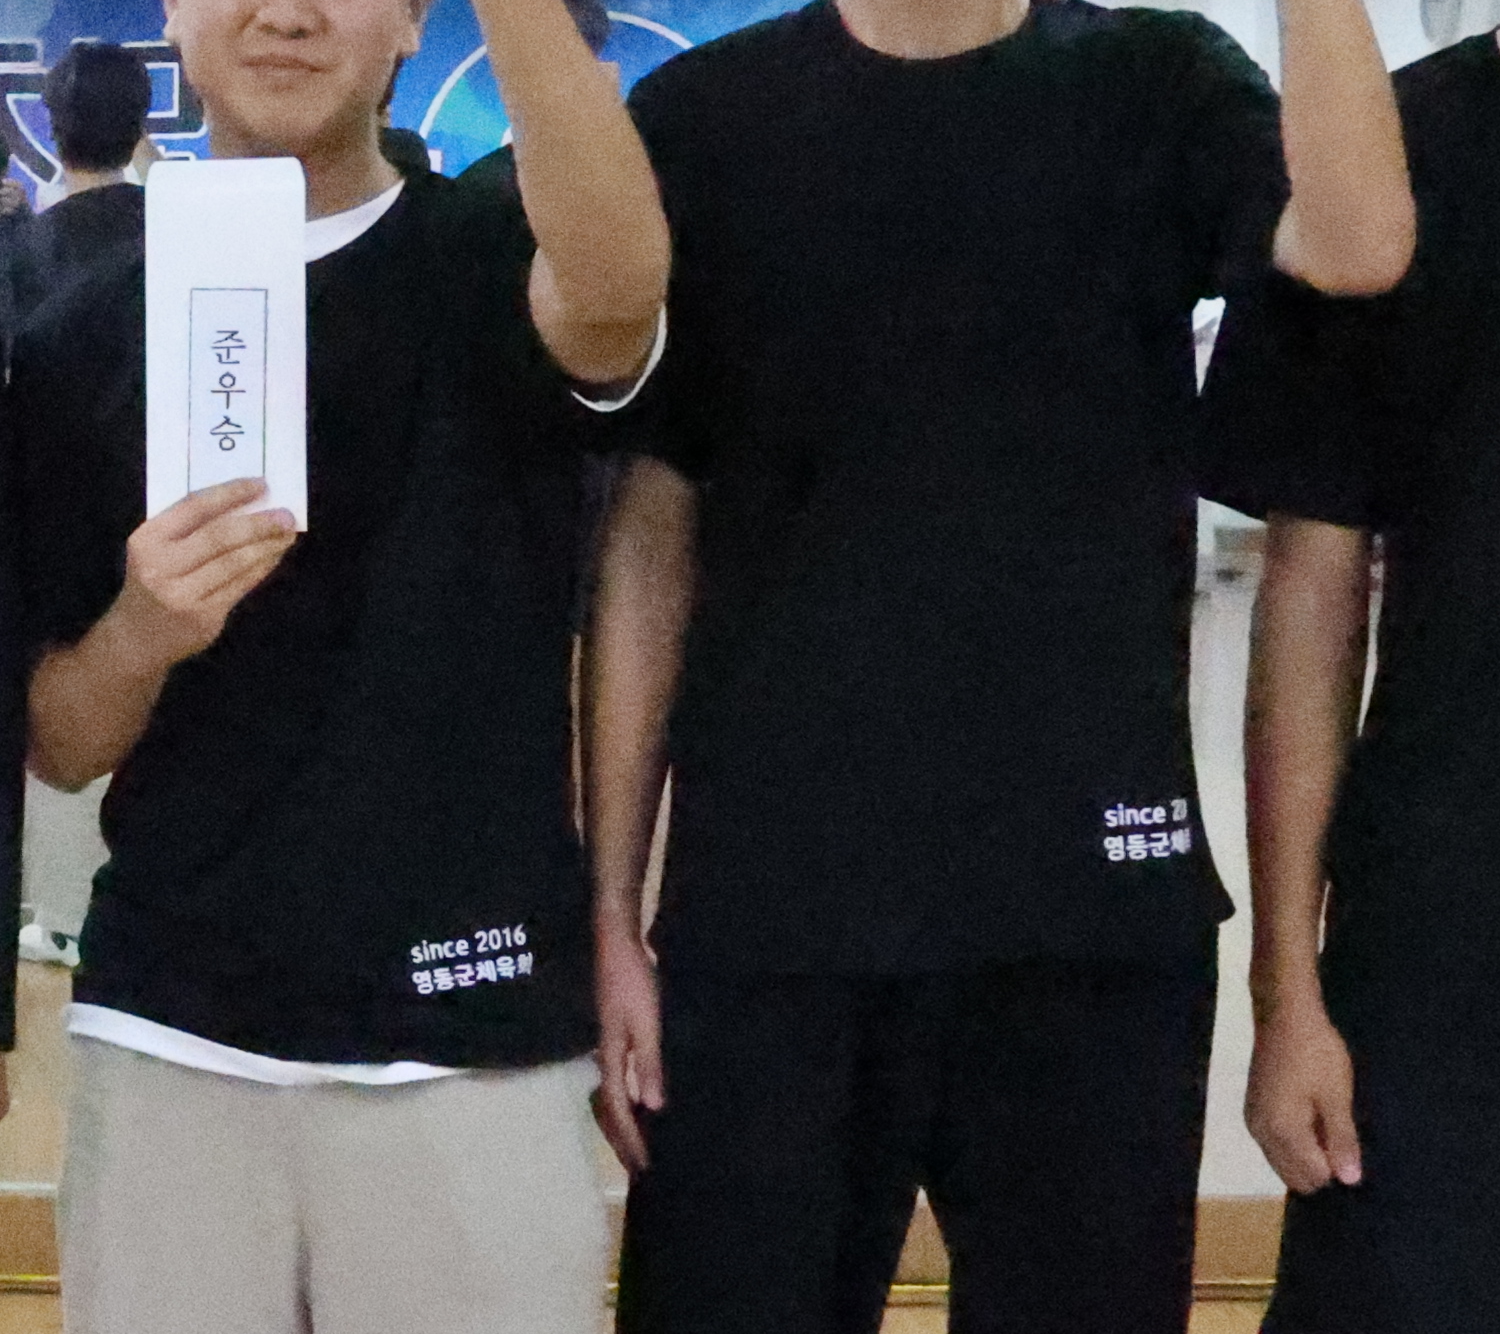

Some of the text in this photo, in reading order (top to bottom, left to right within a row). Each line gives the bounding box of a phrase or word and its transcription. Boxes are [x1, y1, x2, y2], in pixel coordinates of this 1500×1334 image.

[210, 330, 247, 451] 준우승
[1104, 802, 1167, 828] since
[410, 923, 527, 964] since 2016
[411, 952, 534, 995] 영동군체육회
